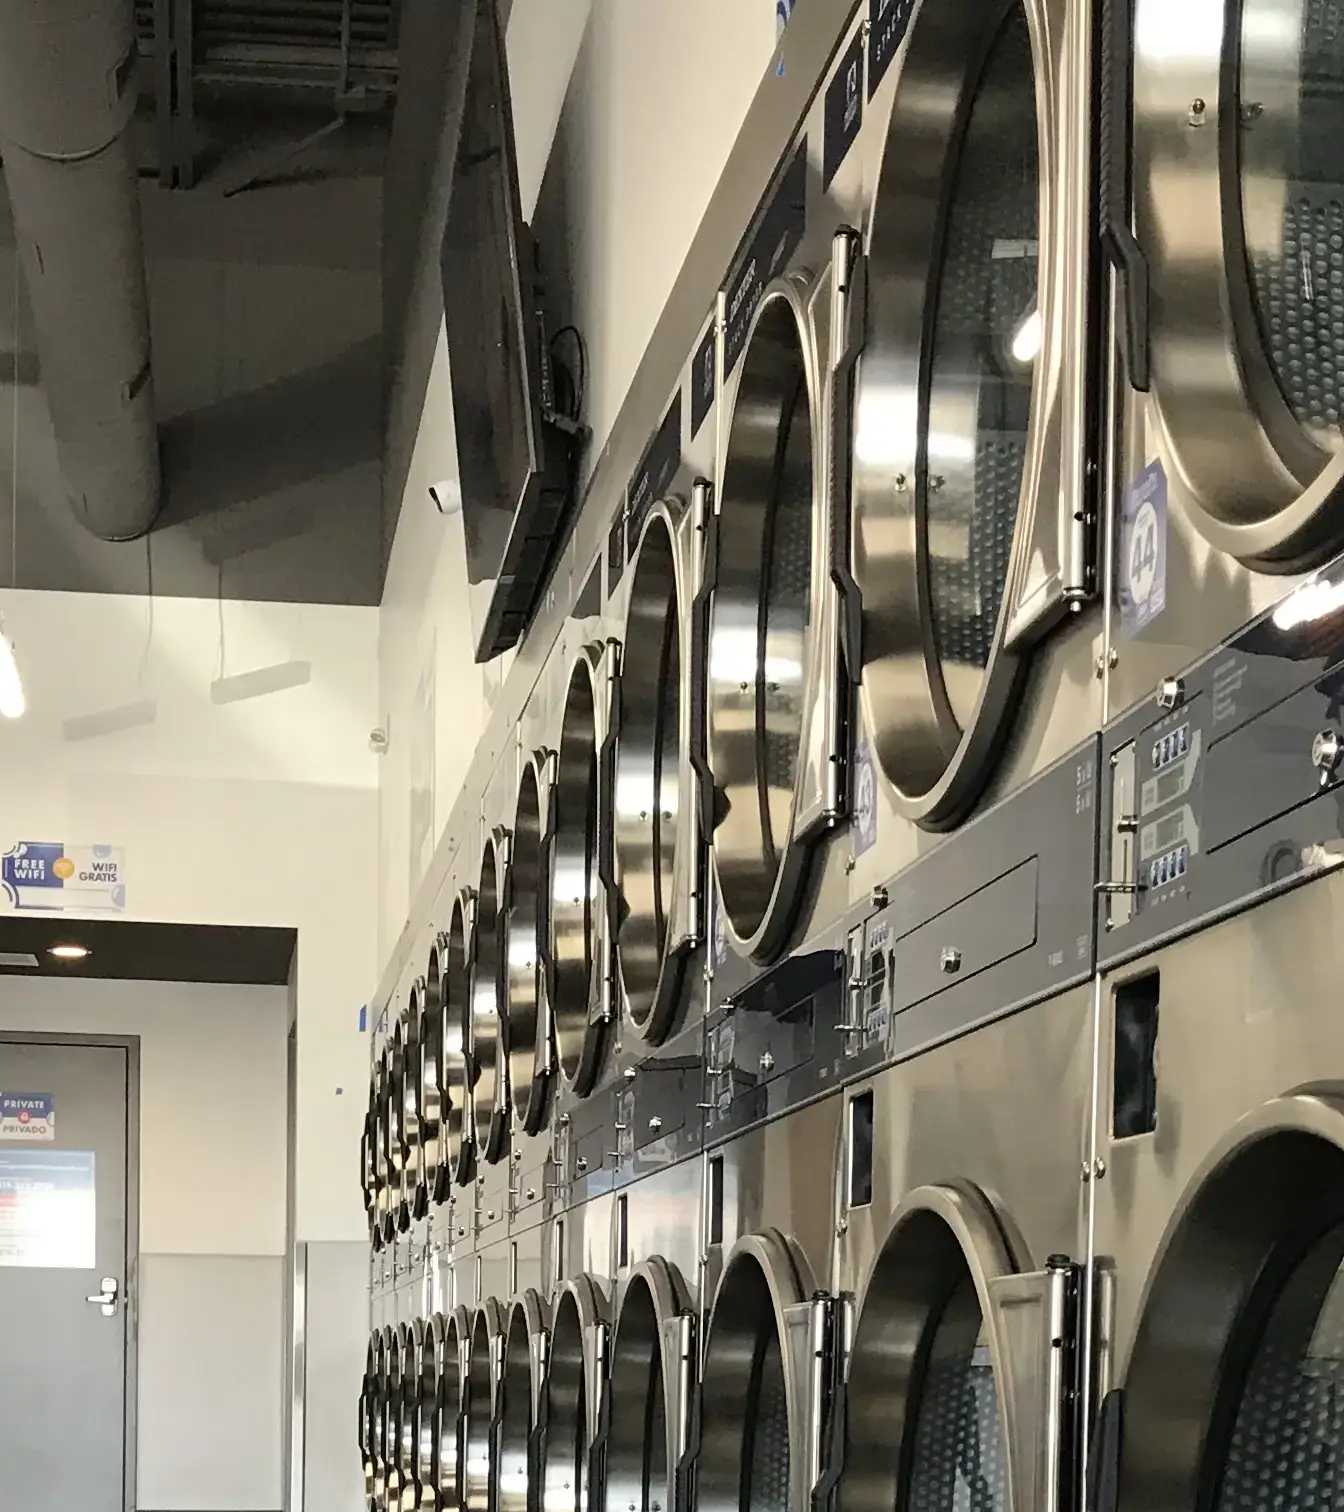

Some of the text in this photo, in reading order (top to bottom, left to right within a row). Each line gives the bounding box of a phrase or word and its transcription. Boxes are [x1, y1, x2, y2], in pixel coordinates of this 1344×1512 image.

[1130, 523, 1155, 583] 44
[14, 859, 45, 869] FREE
[92, 862, 117, 872] WIFI
[14, 869, 45, 880] WIFI
[79, 871, 117, 883] GRATIS
[3, 1099, 45, 1109] PRIVATE
[2, 1125, 46, 1134] PRIVADO
